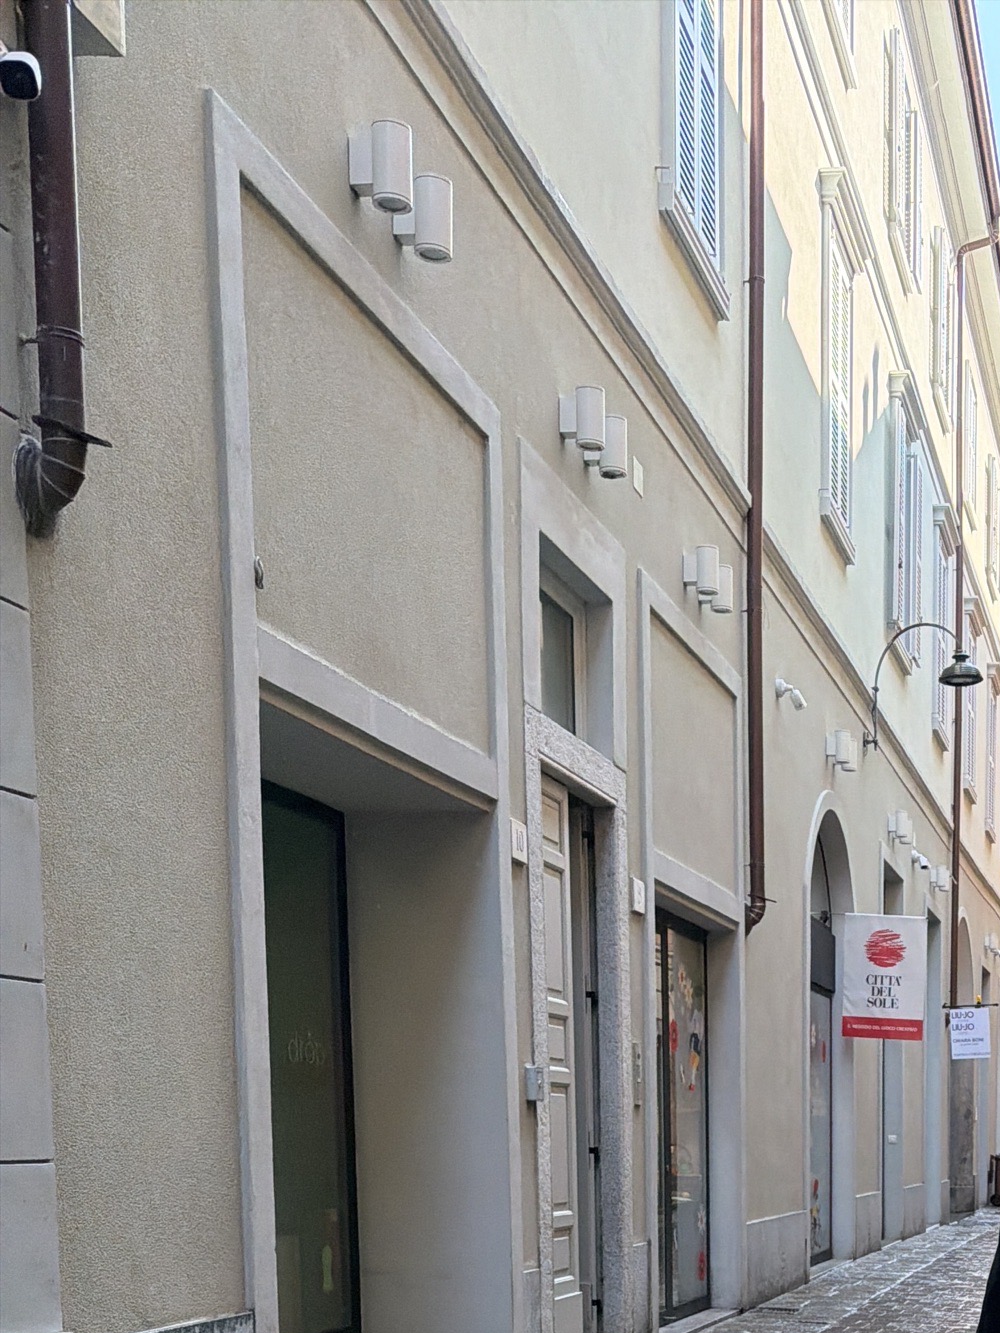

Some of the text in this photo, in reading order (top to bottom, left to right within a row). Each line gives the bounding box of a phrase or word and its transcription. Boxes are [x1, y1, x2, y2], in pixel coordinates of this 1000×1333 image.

[516, 829, 524, 853] 10
[871, 986, 896, 998] DEL
[866, 997, 899, 1009] SOLE
